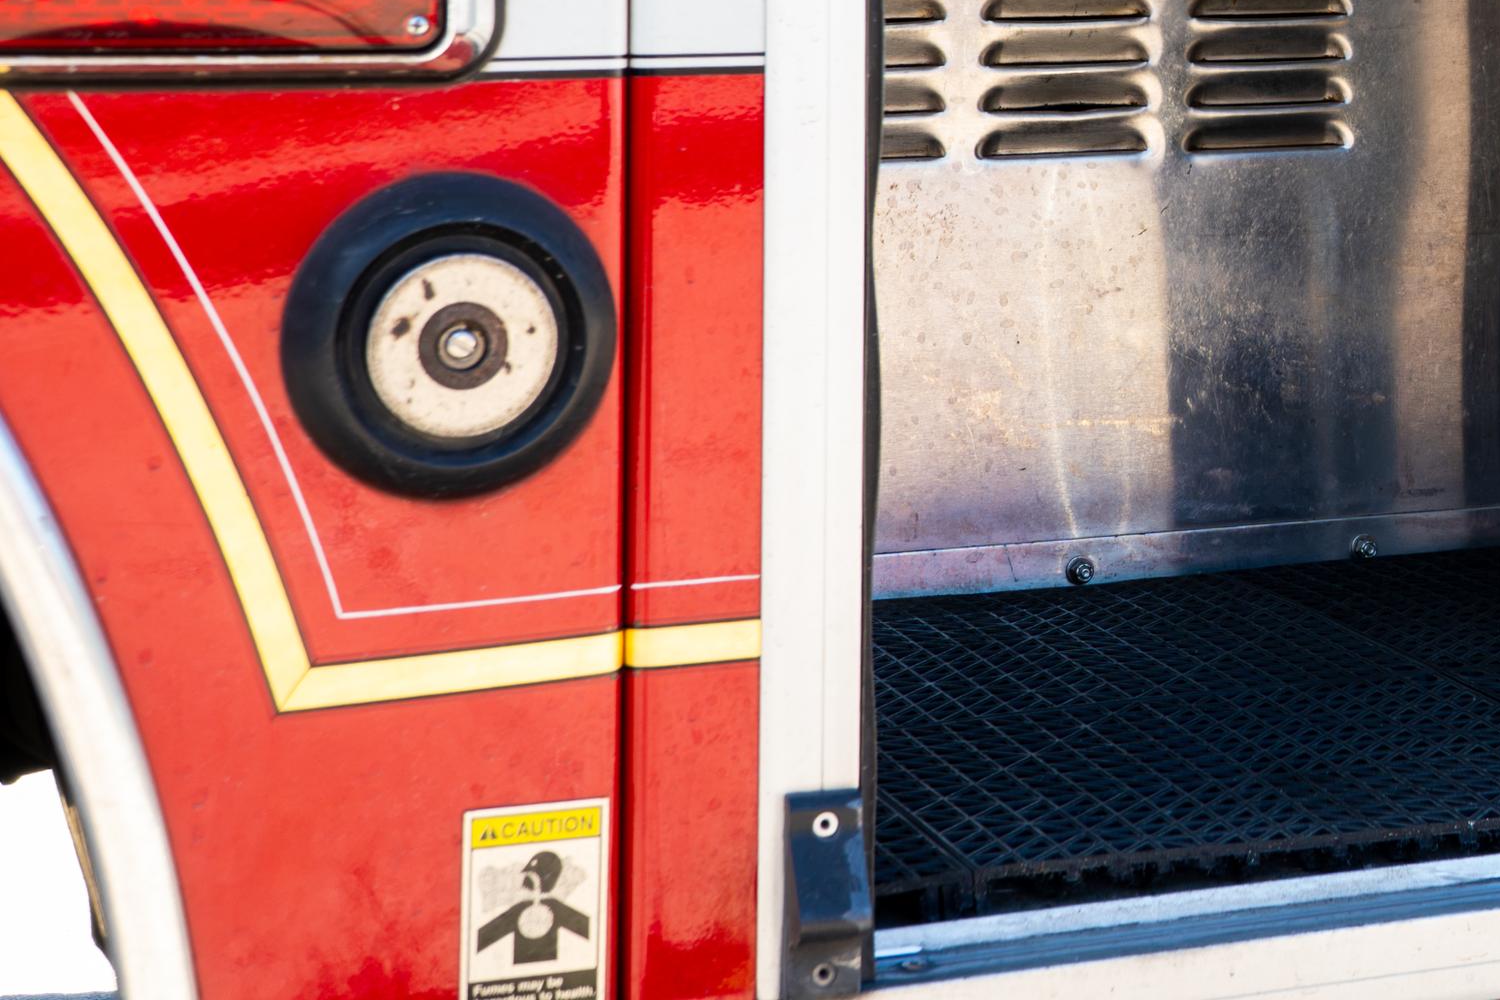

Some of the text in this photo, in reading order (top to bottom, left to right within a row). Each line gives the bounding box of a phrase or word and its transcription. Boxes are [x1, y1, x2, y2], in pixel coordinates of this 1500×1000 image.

[501, 815, 594, 839] CAUTION
[472, 983, 515, 998] Fumes
[516, 979, 545, 993] may
[546, 976, 564, 990] be
